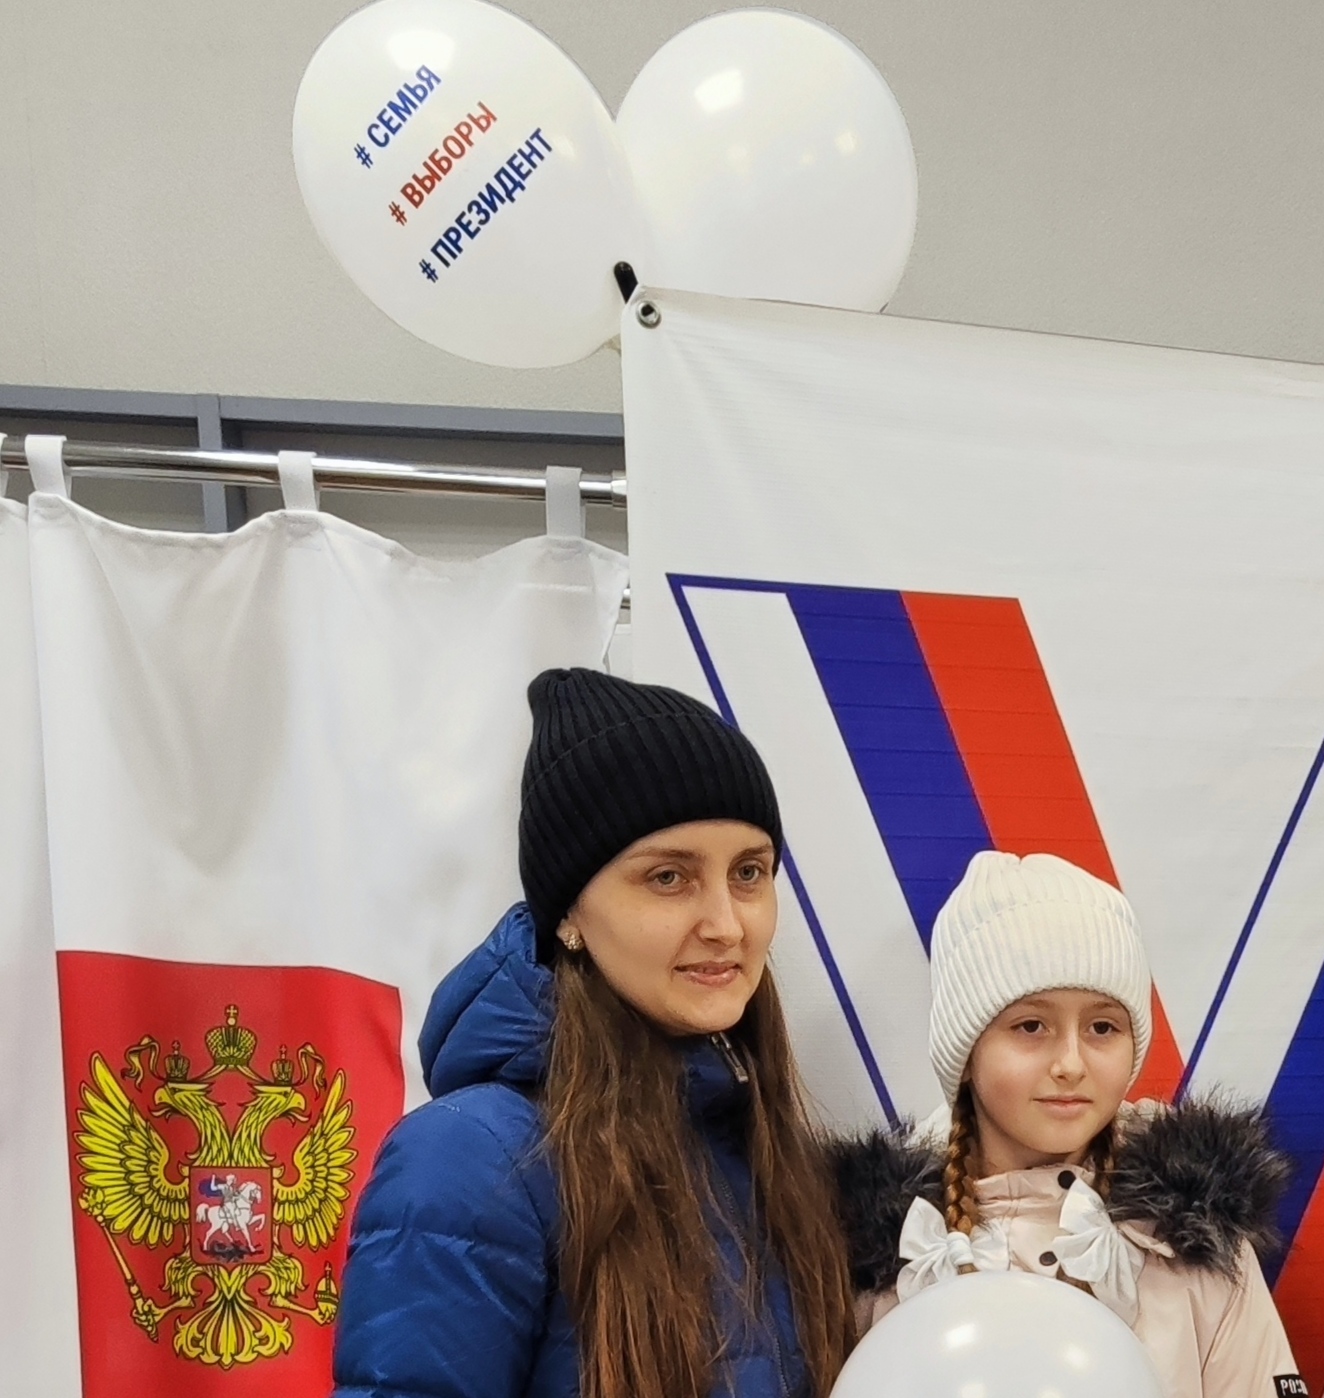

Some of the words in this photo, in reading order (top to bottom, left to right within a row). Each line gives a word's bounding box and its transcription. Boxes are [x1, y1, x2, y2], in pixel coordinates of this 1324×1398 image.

[367, 64, 441, 149] СЕМЬЯ
[401, 101, 497, 210] ВЫБОРЫ
[430, 127, 554, 269] ПРЕЗИДЕНТ
